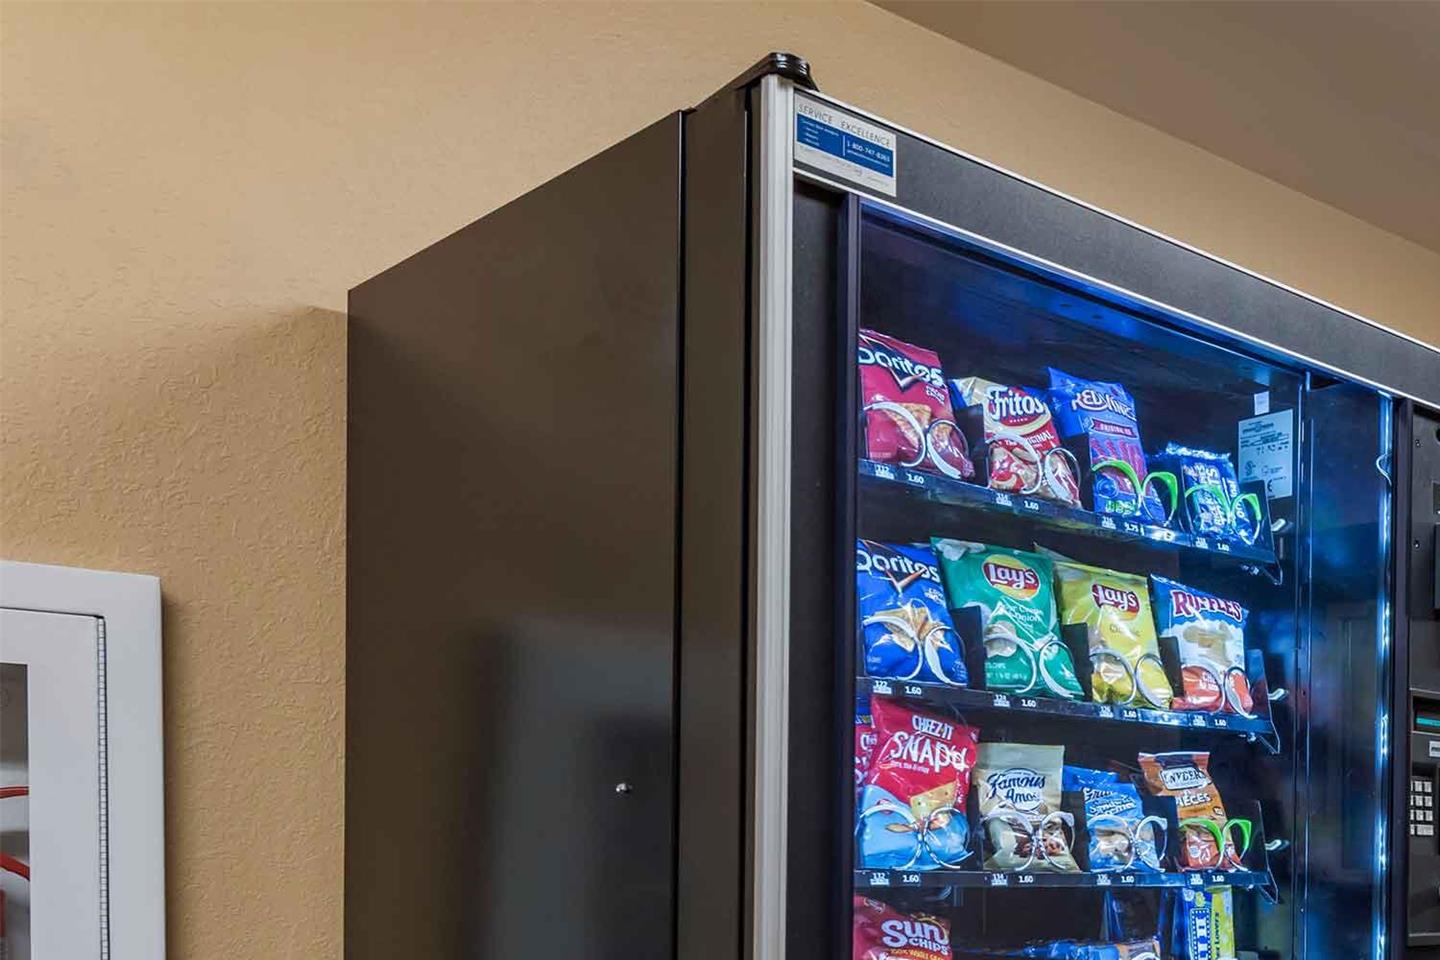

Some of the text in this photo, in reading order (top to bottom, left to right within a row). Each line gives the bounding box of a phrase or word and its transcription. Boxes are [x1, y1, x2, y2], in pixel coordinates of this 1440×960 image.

[799, 104, 833, 124] SERVICE
[841, 120, 891, 147] EXCELLENCE
[858, 346, 946, 387] Doritos
[983, 385, 1042, 419] Fritos
[906, 472, 924, 485] 1.60
[857, 549, 941, 584] Doritos
[989, 563, 1037, 589] Lay's
[1097, 586, 1138, 611] Lay's
[1172, 590, 1242, 622] RUFFLES
[905, 686, 922, 695] 1.60
[1021, 699, 1036, 708] 1.60
[1123, 710, 1137, 718] 1.60
[1214, 718, 1227, 726] 1.60
[987, 770, 1046, 800] Famous
[903, 875, 919, 883] 1.60
[1019, 875, 1033, 883] 1.60
[1121, 875, 1135, 883] 1.60
[881, 920, 949, 948] Sun
[909, 936, 949, 956] CHIPS
